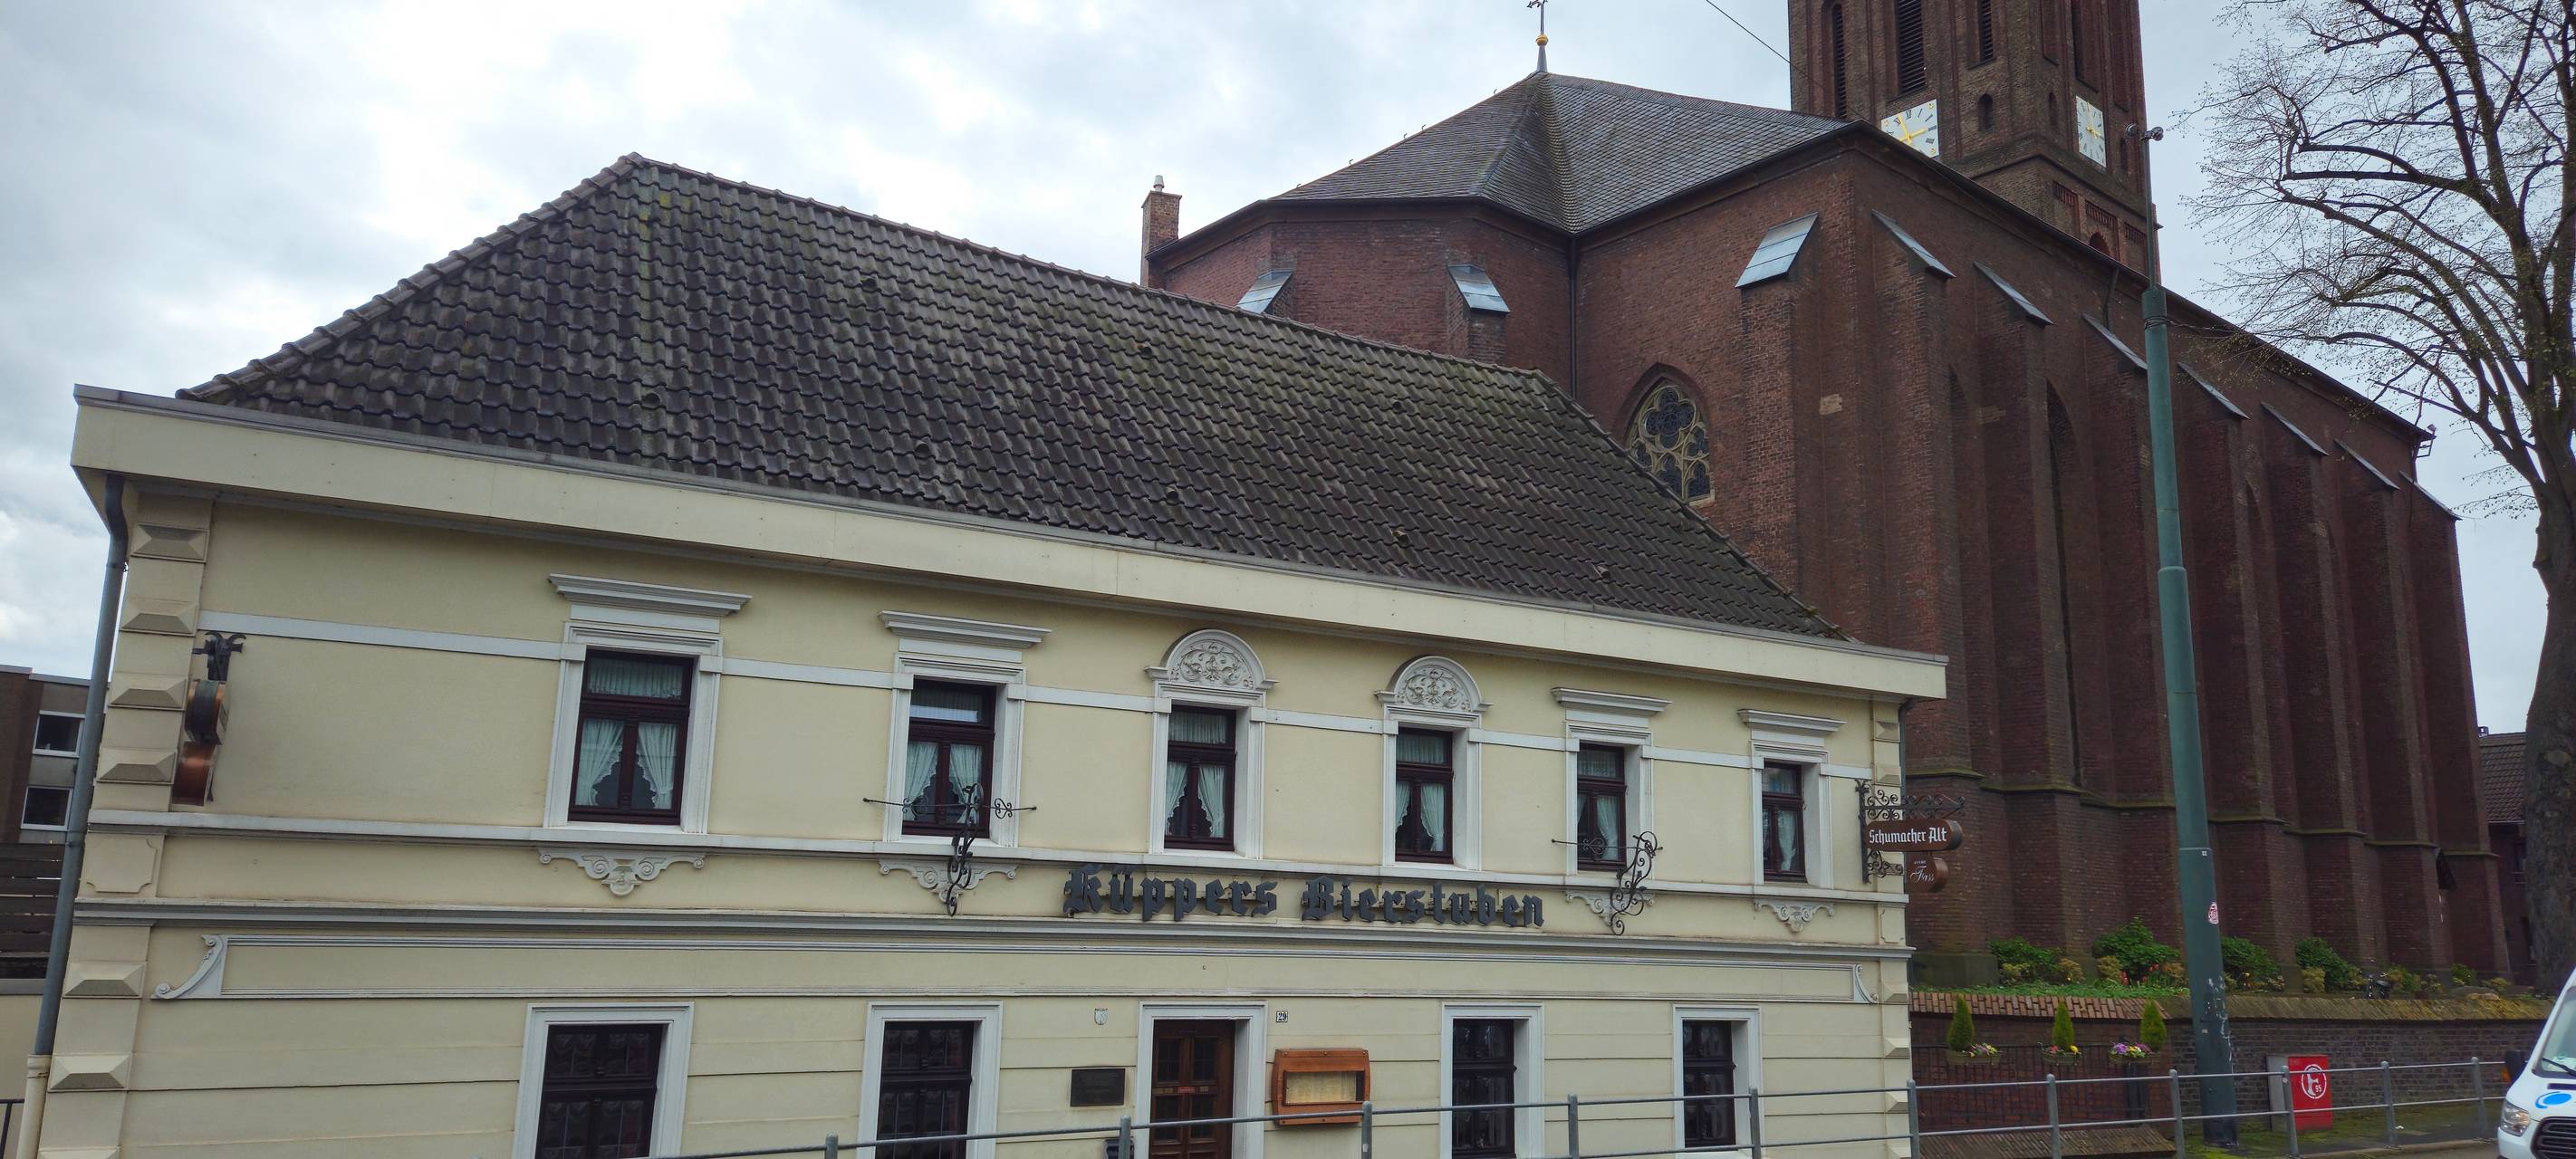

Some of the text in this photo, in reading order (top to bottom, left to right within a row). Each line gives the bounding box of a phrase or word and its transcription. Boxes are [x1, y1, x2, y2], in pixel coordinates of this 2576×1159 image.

[1869, 826, 1947, 845] Schumacher Alt
[1063, 864, 1545, 928] Küppers Bierstuben
[1277, 1011, 1287, 1021] 29
